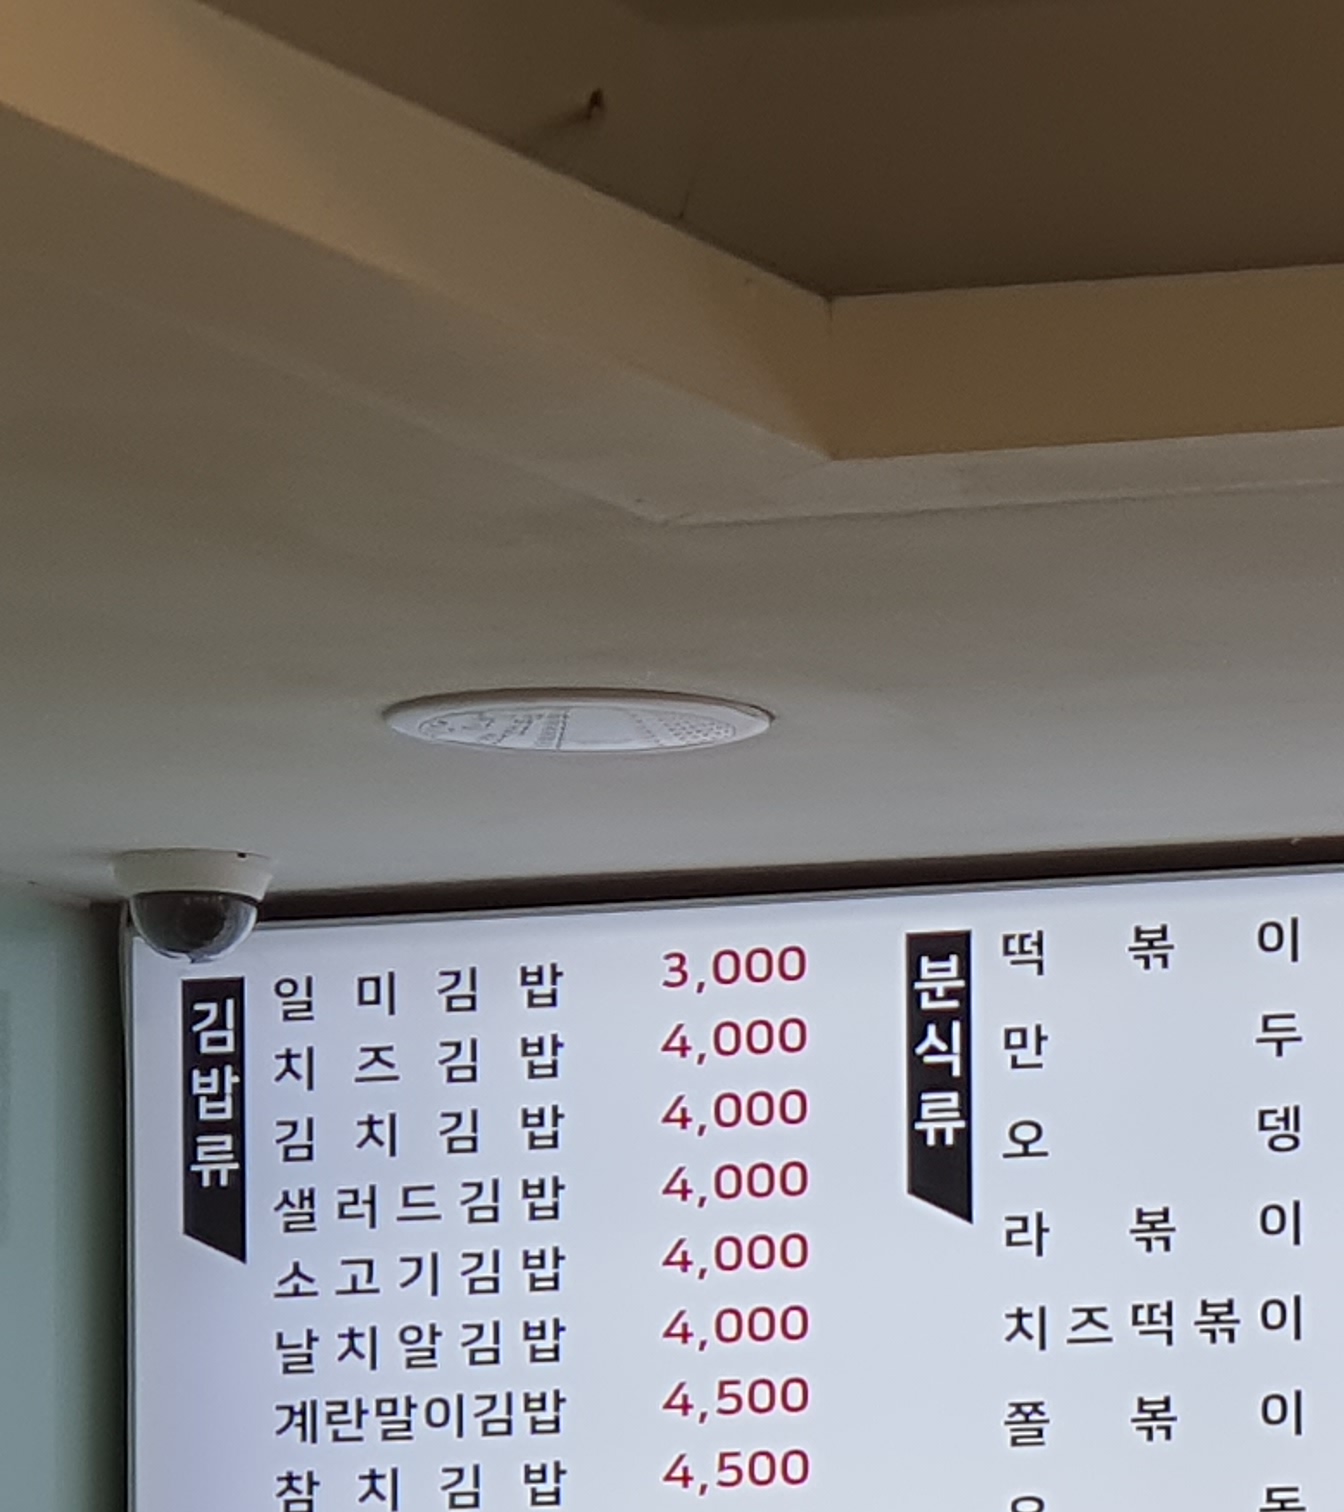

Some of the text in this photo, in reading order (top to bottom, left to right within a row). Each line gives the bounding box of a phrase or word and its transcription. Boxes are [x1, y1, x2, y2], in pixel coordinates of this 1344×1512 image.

[663, 946, 806, 994] 3,000
[661, 1018, 807, 1065] 4,000
[912, 953, 966, 1147] 분식류
[189, 998, 240, 1189] 김밥류
[661, 1089, 807, 1136] 4,000
[662, 1161, 808, 1208] 4,000
[662, 1233, 808, 1280] 4,000
[663, 1305, 808, 1351] 4,000
[275, 1377, 808, 1444] 계란말이김밥 4,500
[663, 1449, 809, 1496] 4,500
